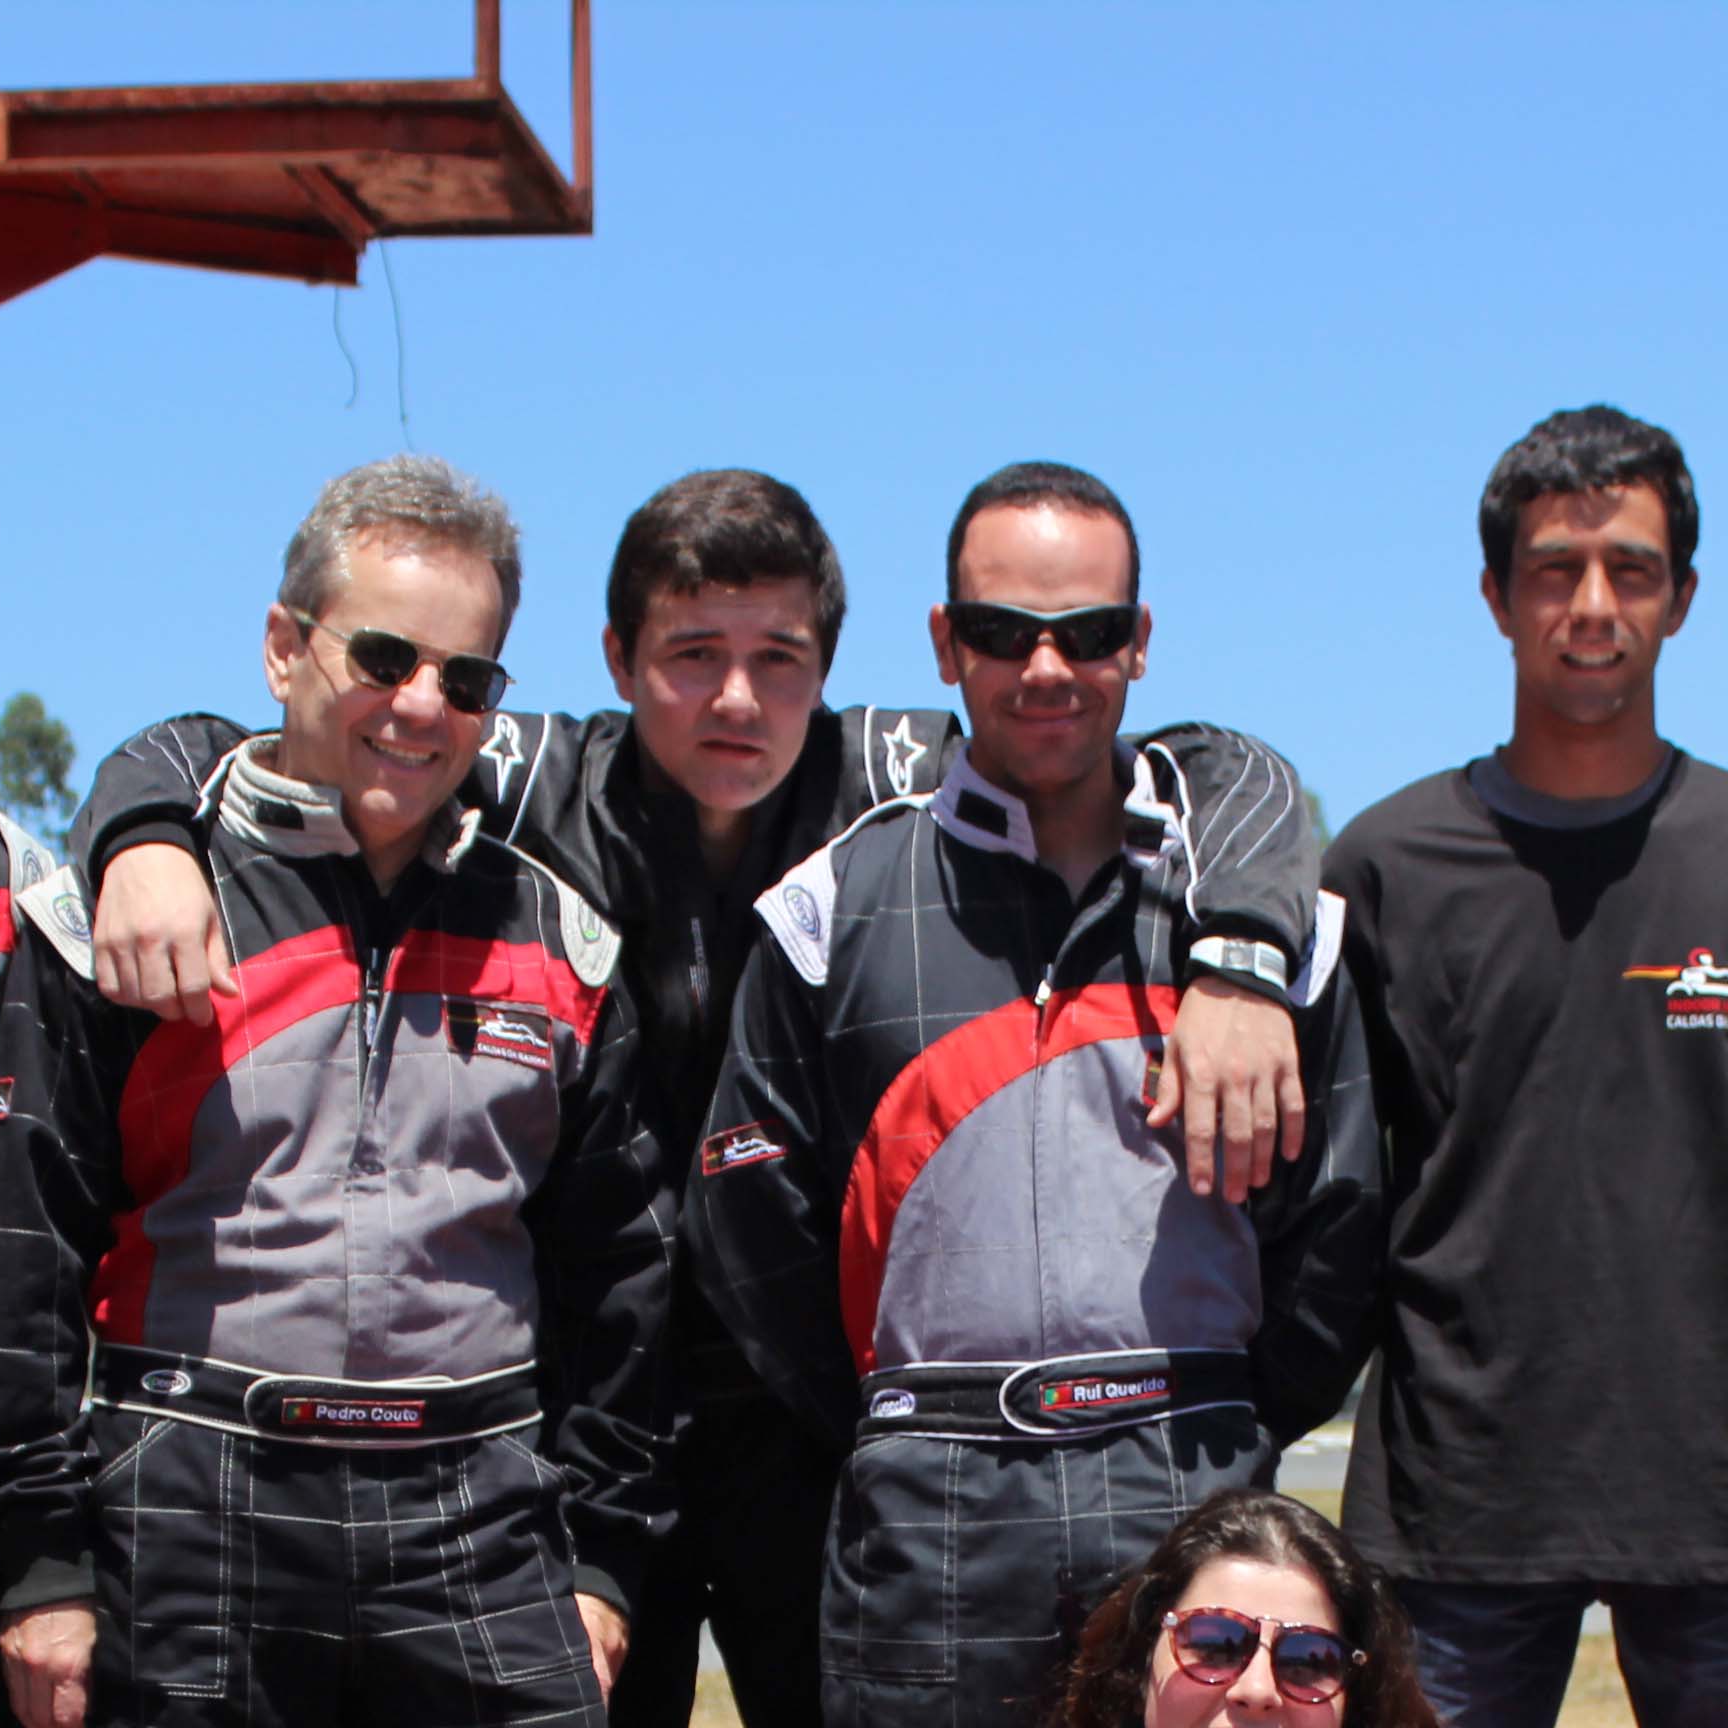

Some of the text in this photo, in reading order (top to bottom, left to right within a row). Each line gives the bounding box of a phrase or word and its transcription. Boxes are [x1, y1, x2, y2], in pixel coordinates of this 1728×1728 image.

[1666, 1013, 1714, 1030] CALDAS
[1073, 1376, 1167, 1402] Rui Querido
[315, 1405, 419, 1422] Pedro Couto
